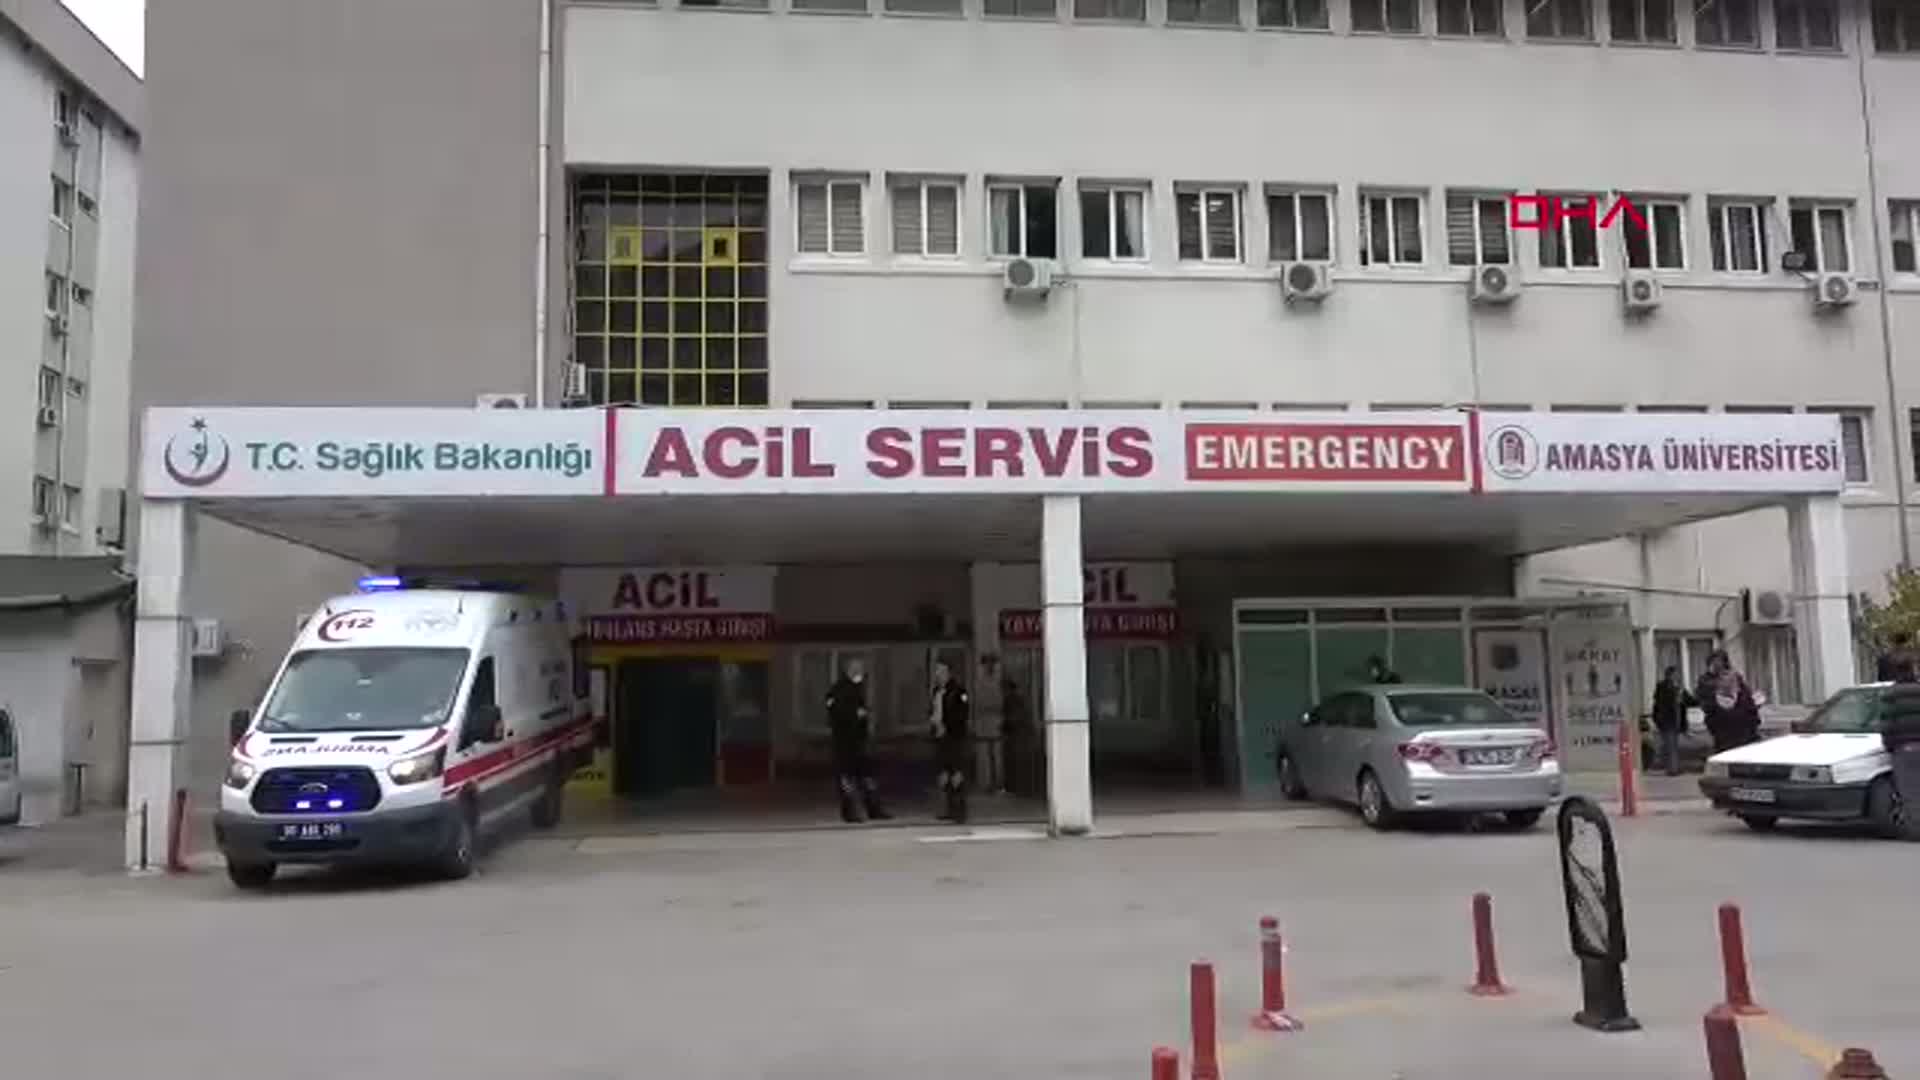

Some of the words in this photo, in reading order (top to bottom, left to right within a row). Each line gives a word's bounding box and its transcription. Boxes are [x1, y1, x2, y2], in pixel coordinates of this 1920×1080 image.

[246, 443, 303, 471] T.C.
[316, 441, 424, 477] Sağlık
[434, 442, 593, 477] Bakanlığı
[1194, 435, 1456, 471] EMERGENCY
[1546, 441, 1654, 471] AMASYA
[333, 616, 375, 632] 112
